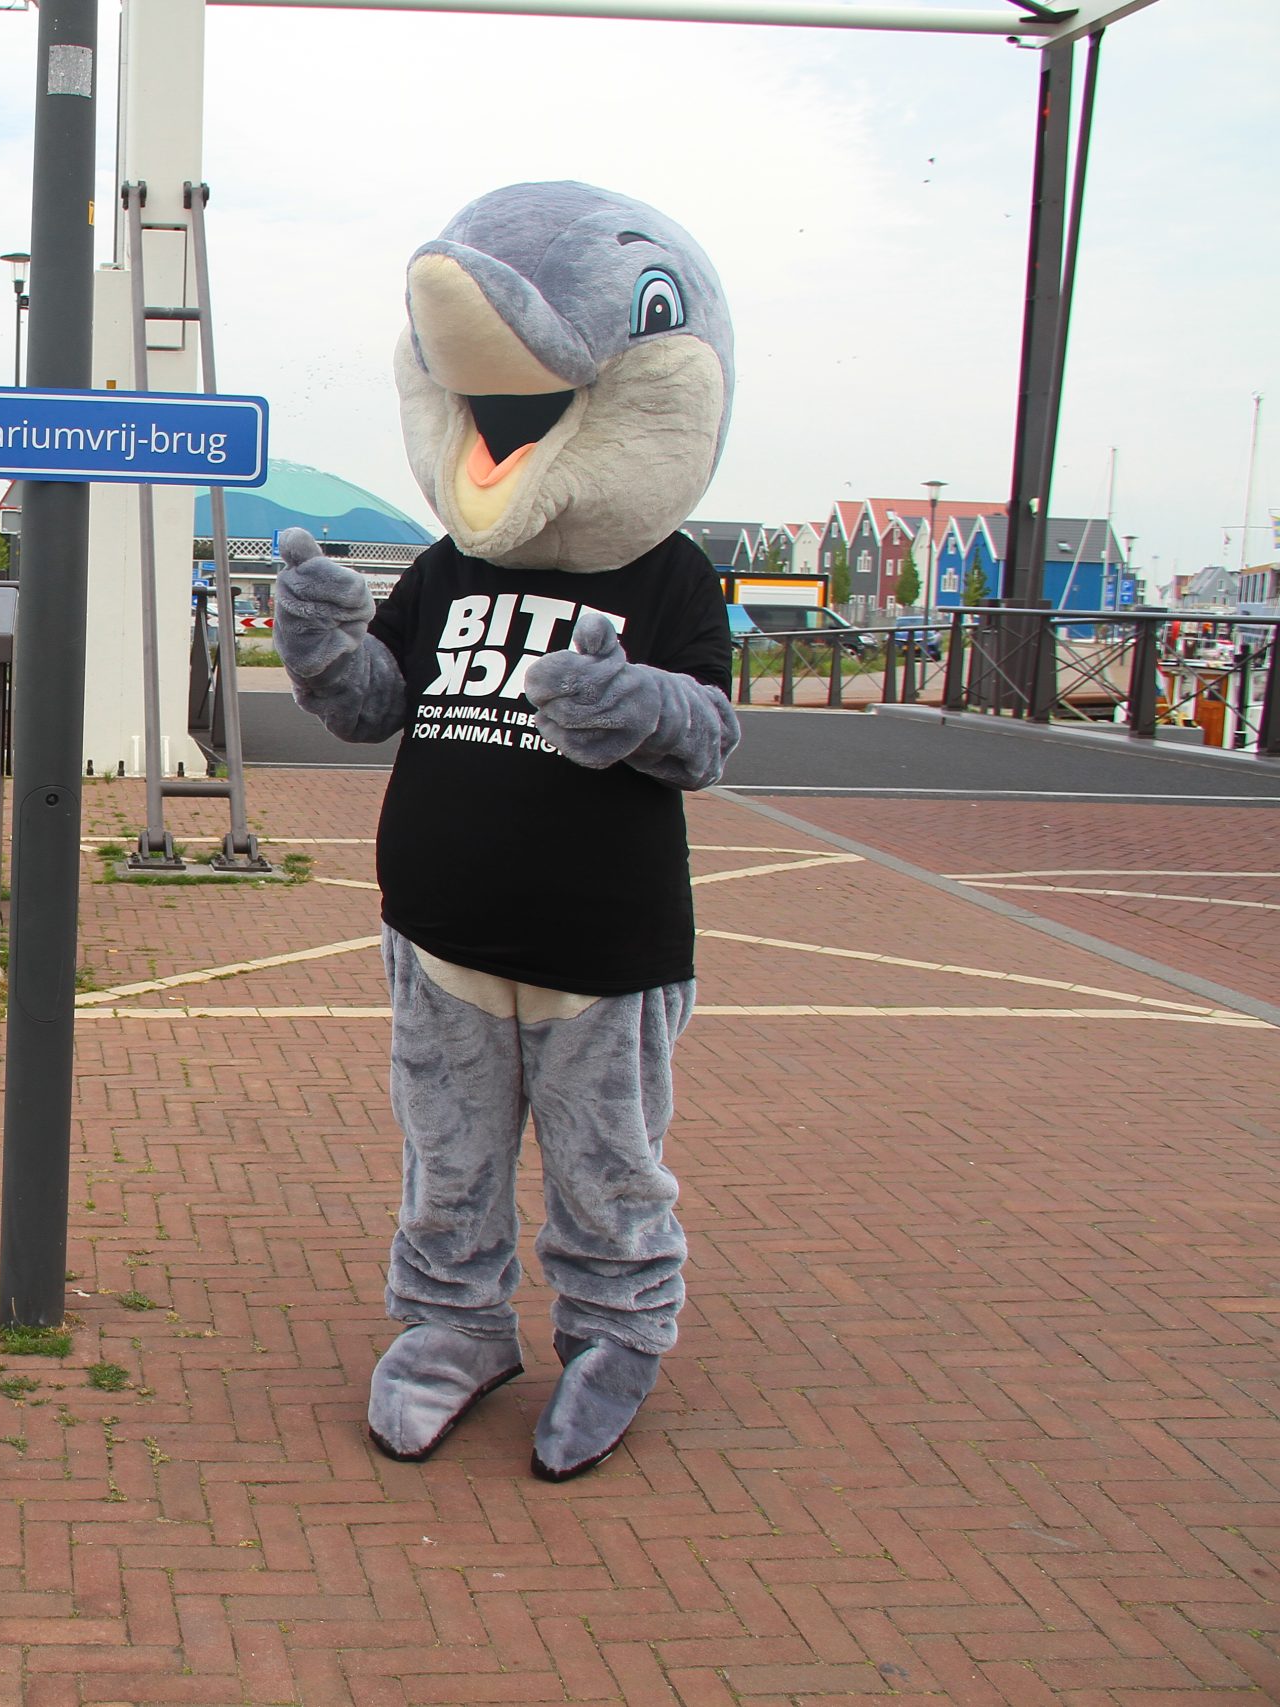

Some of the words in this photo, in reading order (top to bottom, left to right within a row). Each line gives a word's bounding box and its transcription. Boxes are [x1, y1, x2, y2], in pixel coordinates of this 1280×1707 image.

[417, 705, 443, 719] FOR
[443, 706, 498, 722] ANIMAL
[502, 710, 538, 729] LIBE
[412, 723, 441, 739] FOR
[441, 724, 514, 747] ANIMAL
[519, 732, 563, 756] RIG
